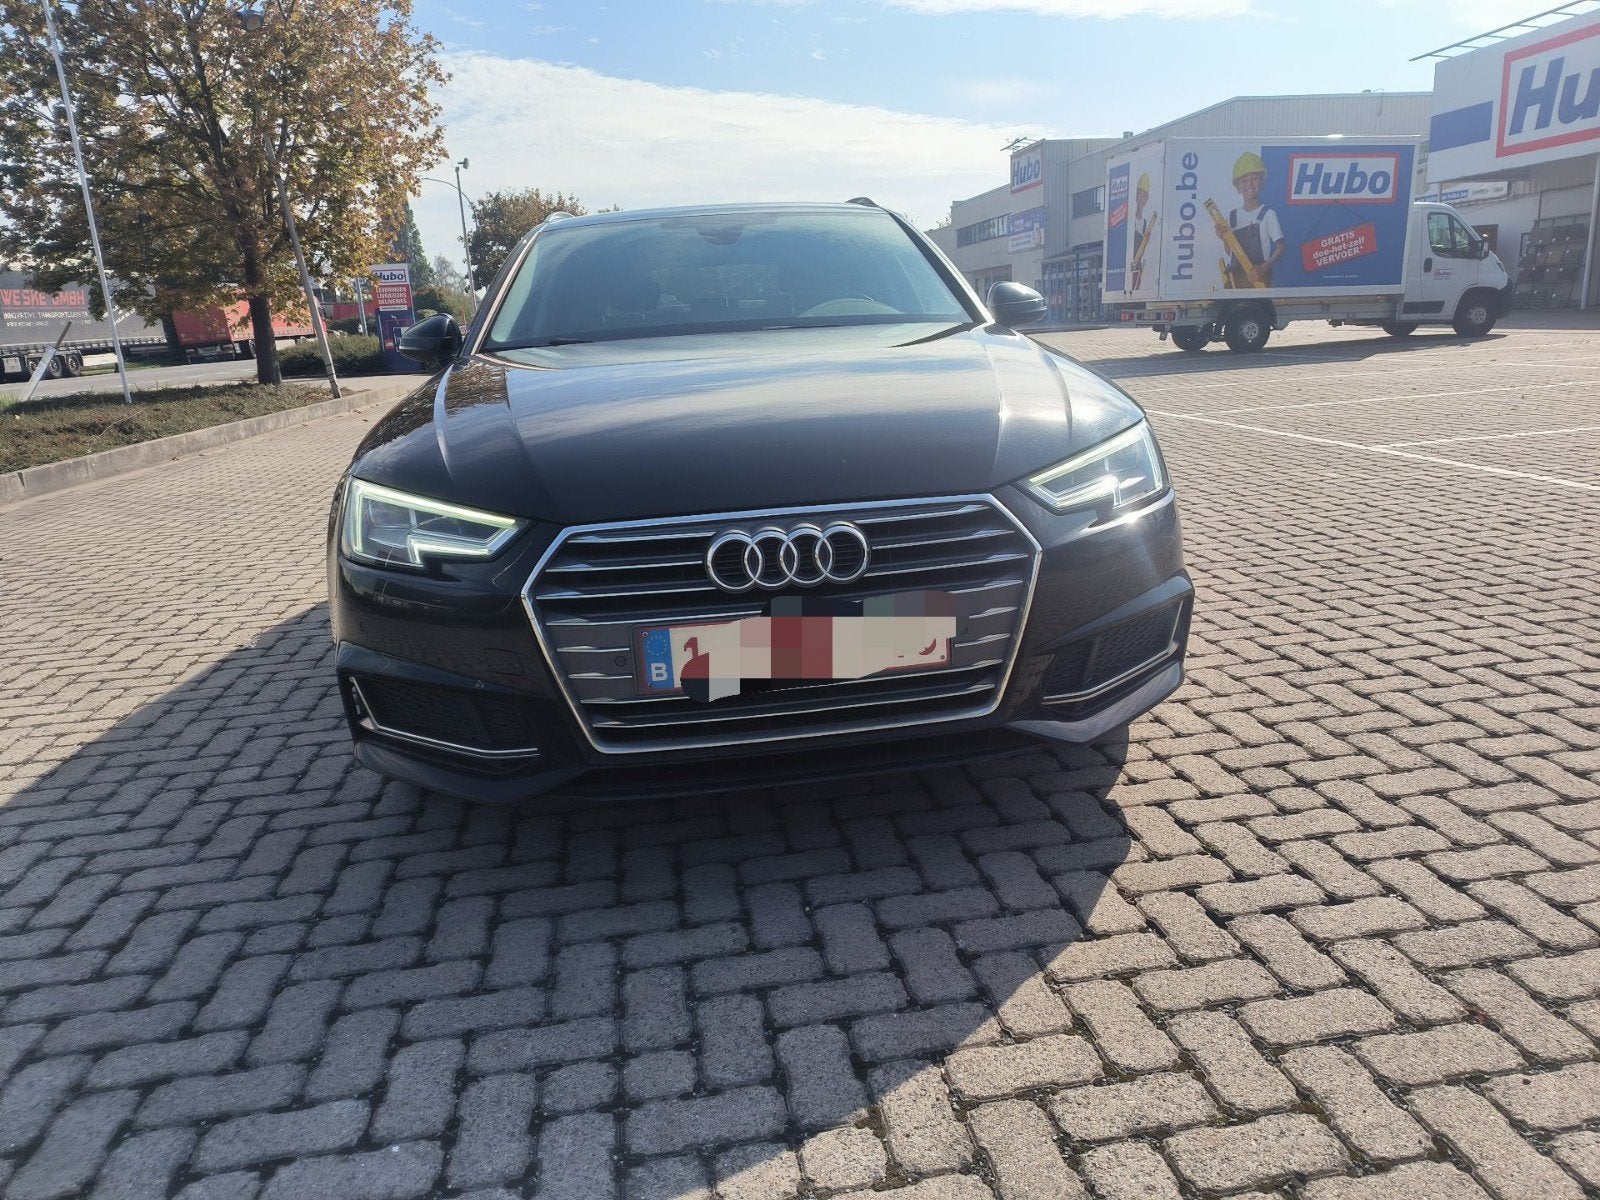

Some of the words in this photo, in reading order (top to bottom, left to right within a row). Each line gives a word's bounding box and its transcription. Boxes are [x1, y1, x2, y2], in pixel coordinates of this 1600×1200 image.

[1012, 156, 1041, 187] Hubo
[1293, 162, 1391, 195] Hubo
[1171, 151, 1199, 281] hubo.be
[1321, 230, 1355, 247] GRATIS
[651, 663, 668, 681] B
